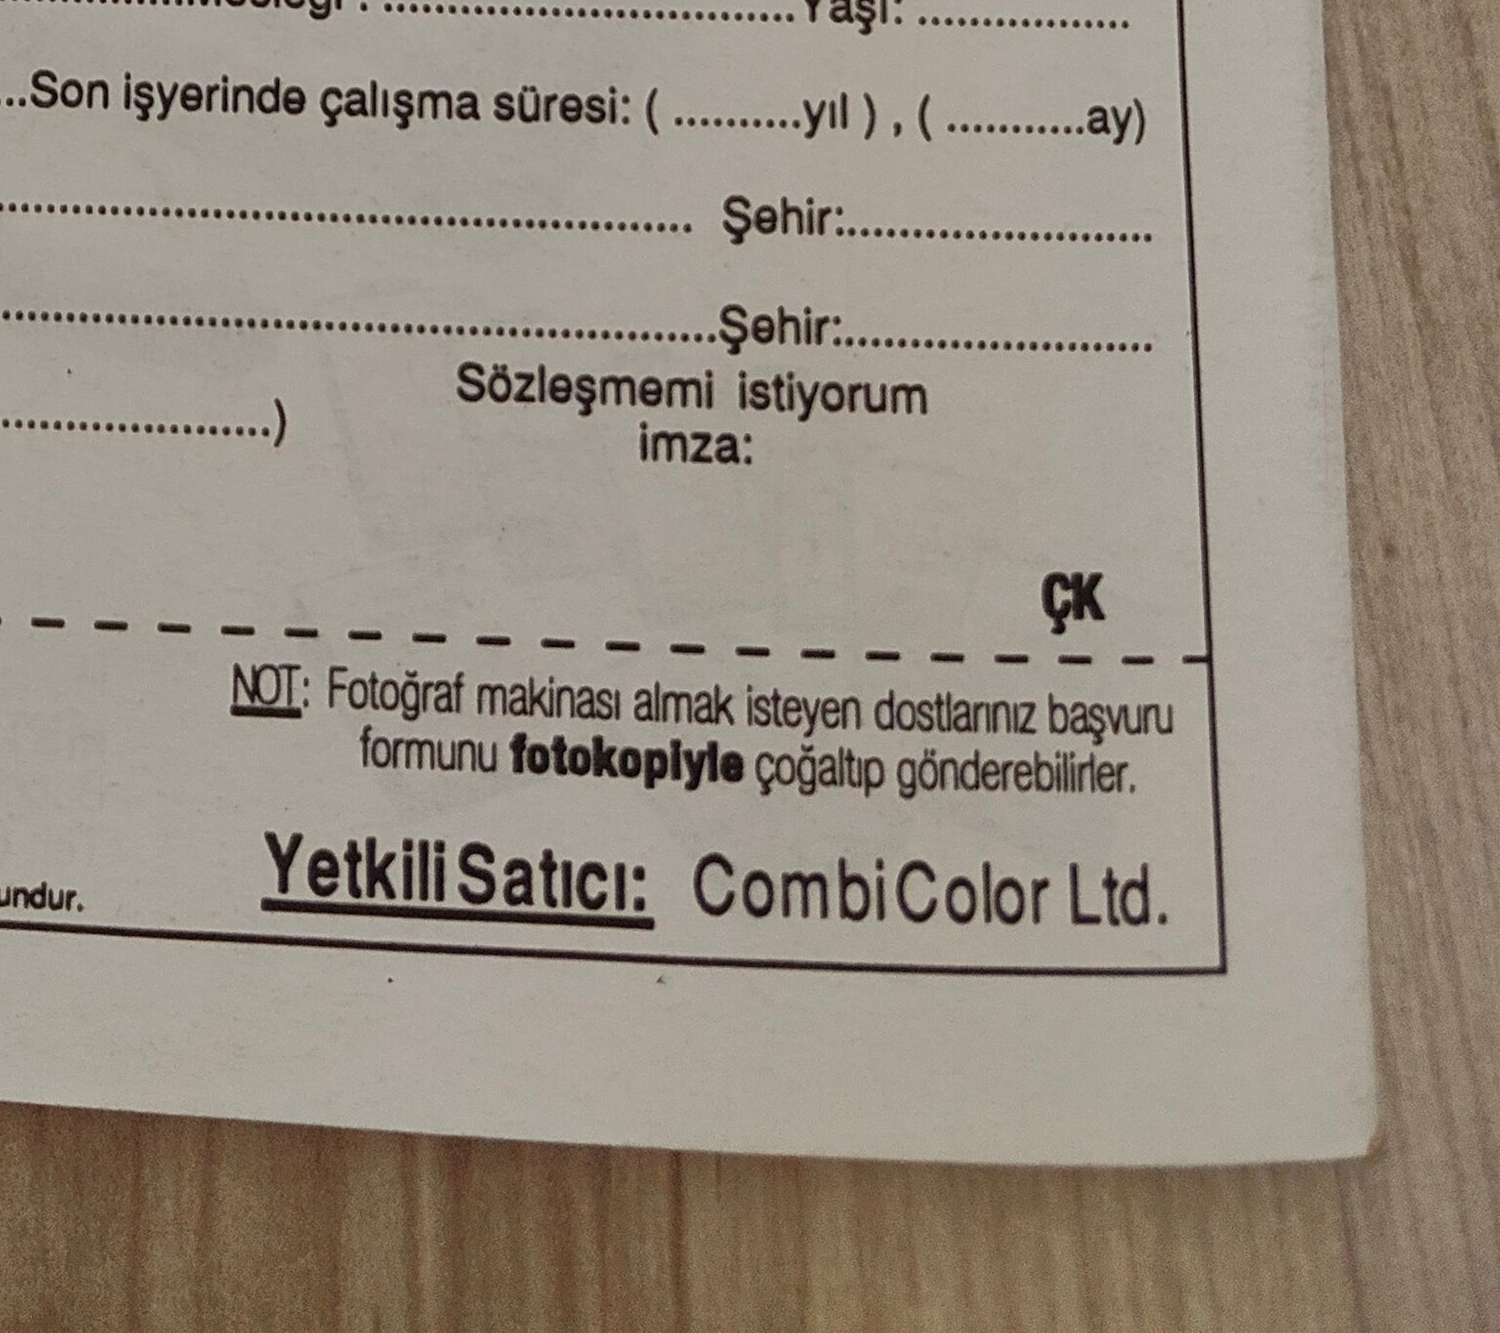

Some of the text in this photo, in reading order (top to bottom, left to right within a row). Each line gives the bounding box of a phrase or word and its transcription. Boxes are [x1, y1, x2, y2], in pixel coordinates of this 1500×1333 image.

[456, 361, 928, 423] Sözleşmemi istiyorum
[639, 421, 752, 465] imza:
[1041, 572, 1106, 636] ÇK
[1069, 862, 1168, 927] Ltd.
